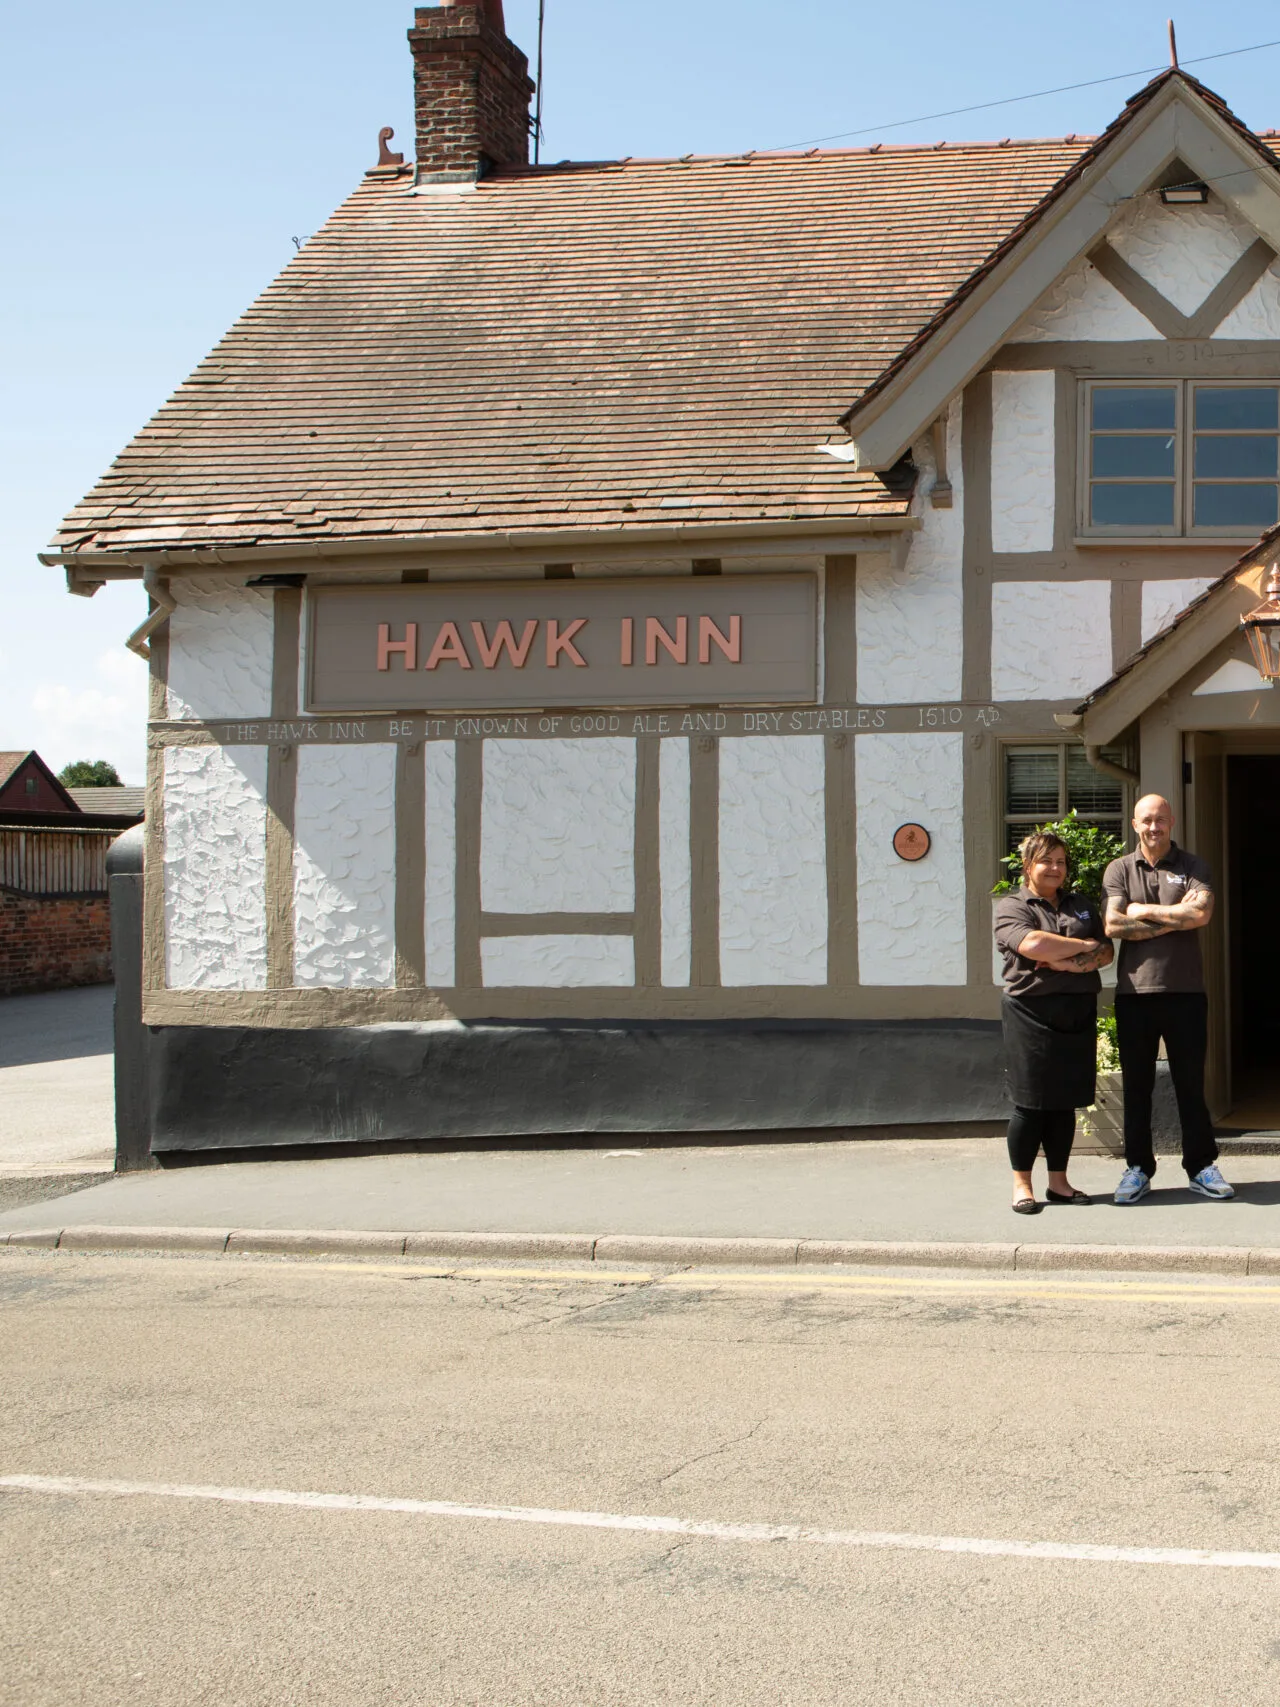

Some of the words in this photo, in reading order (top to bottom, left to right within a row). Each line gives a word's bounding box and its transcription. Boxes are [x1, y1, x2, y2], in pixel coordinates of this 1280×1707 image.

[376, 619, 589, 671] HAWK
[620, 615, 742, 666] INN
[222, 724, 260, 741] THE
[267, 722, 319, 740] HAWK
[329, 722, 366, 740] INN
[389, 720, 414, 737] BE
[424, 719, 446, 736] IT
[454, 717, 529, 736] KNOWN
[538, 716, 563, 733] OF
[570, 715, 620, 732] GOOD
[632, 714, 670, 732] ALE
[680, 712, 727, 731] AND
[743, 712, 784, 731] DRY
[789, 709, 887, 730] STABLES
[918, 707, 963, 727] 1510
